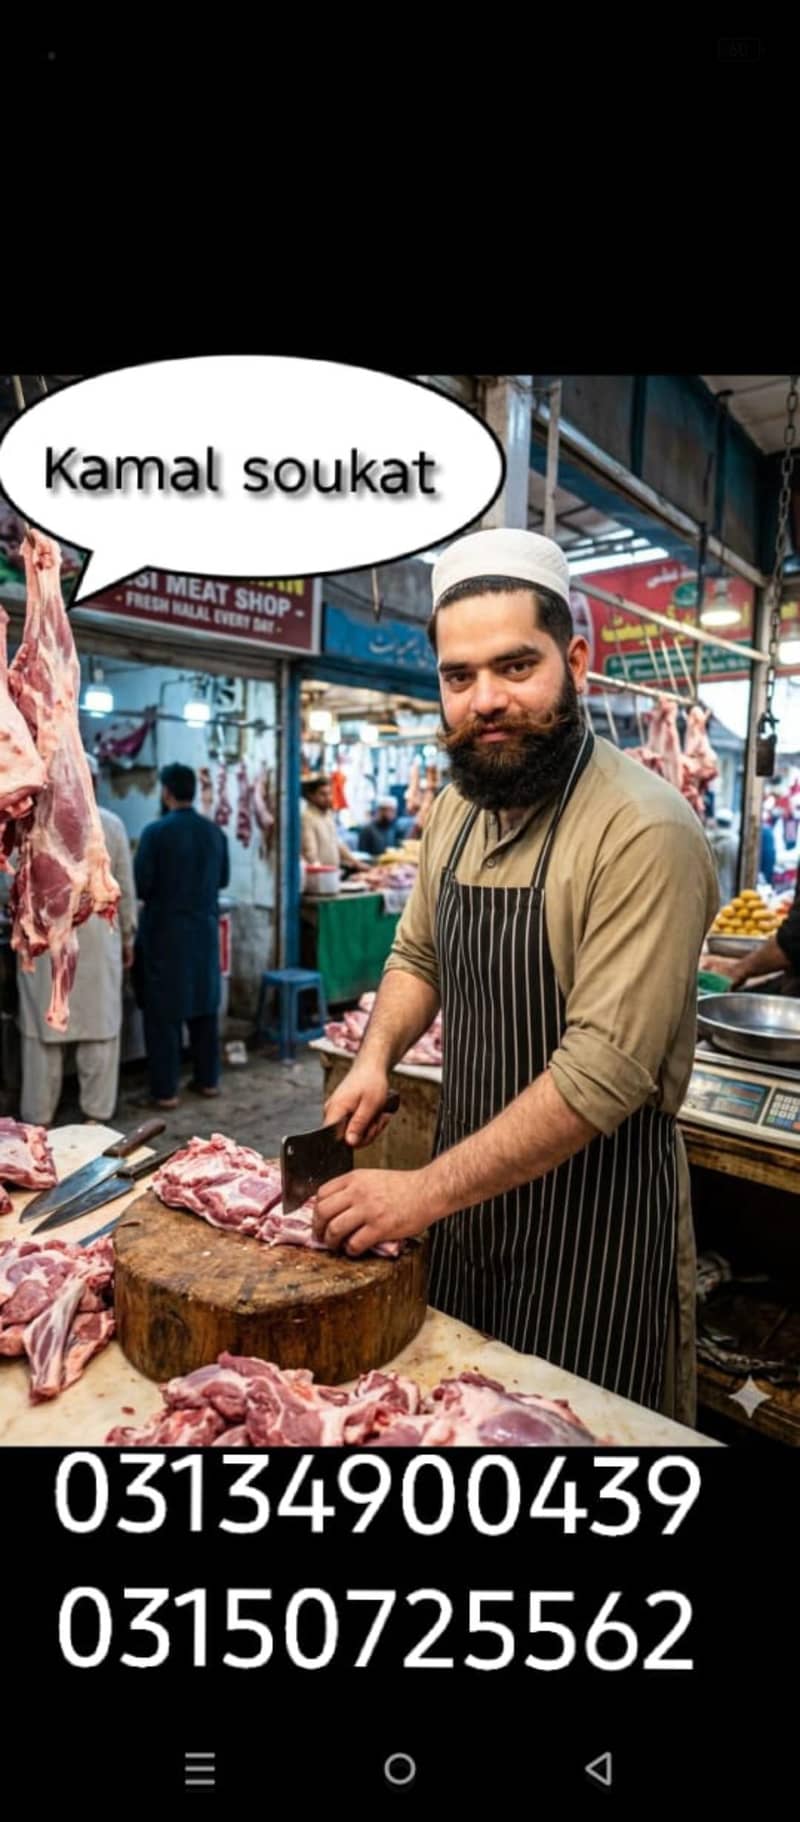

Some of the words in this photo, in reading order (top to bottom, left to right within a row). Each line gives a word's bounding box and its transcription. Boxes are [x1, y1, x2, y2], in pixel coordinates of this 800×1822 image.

[125, 591, 171, 614] FRESH
[172, 599, 212, 622] HALAL
[213, 607, 251, 630] EVERY
[251, 616, 275, 634] DAY
[126, 570, 158, 592] SI
[166, 574, 229, 606] MEAT
[234, 587, 292, 618] SHOP
